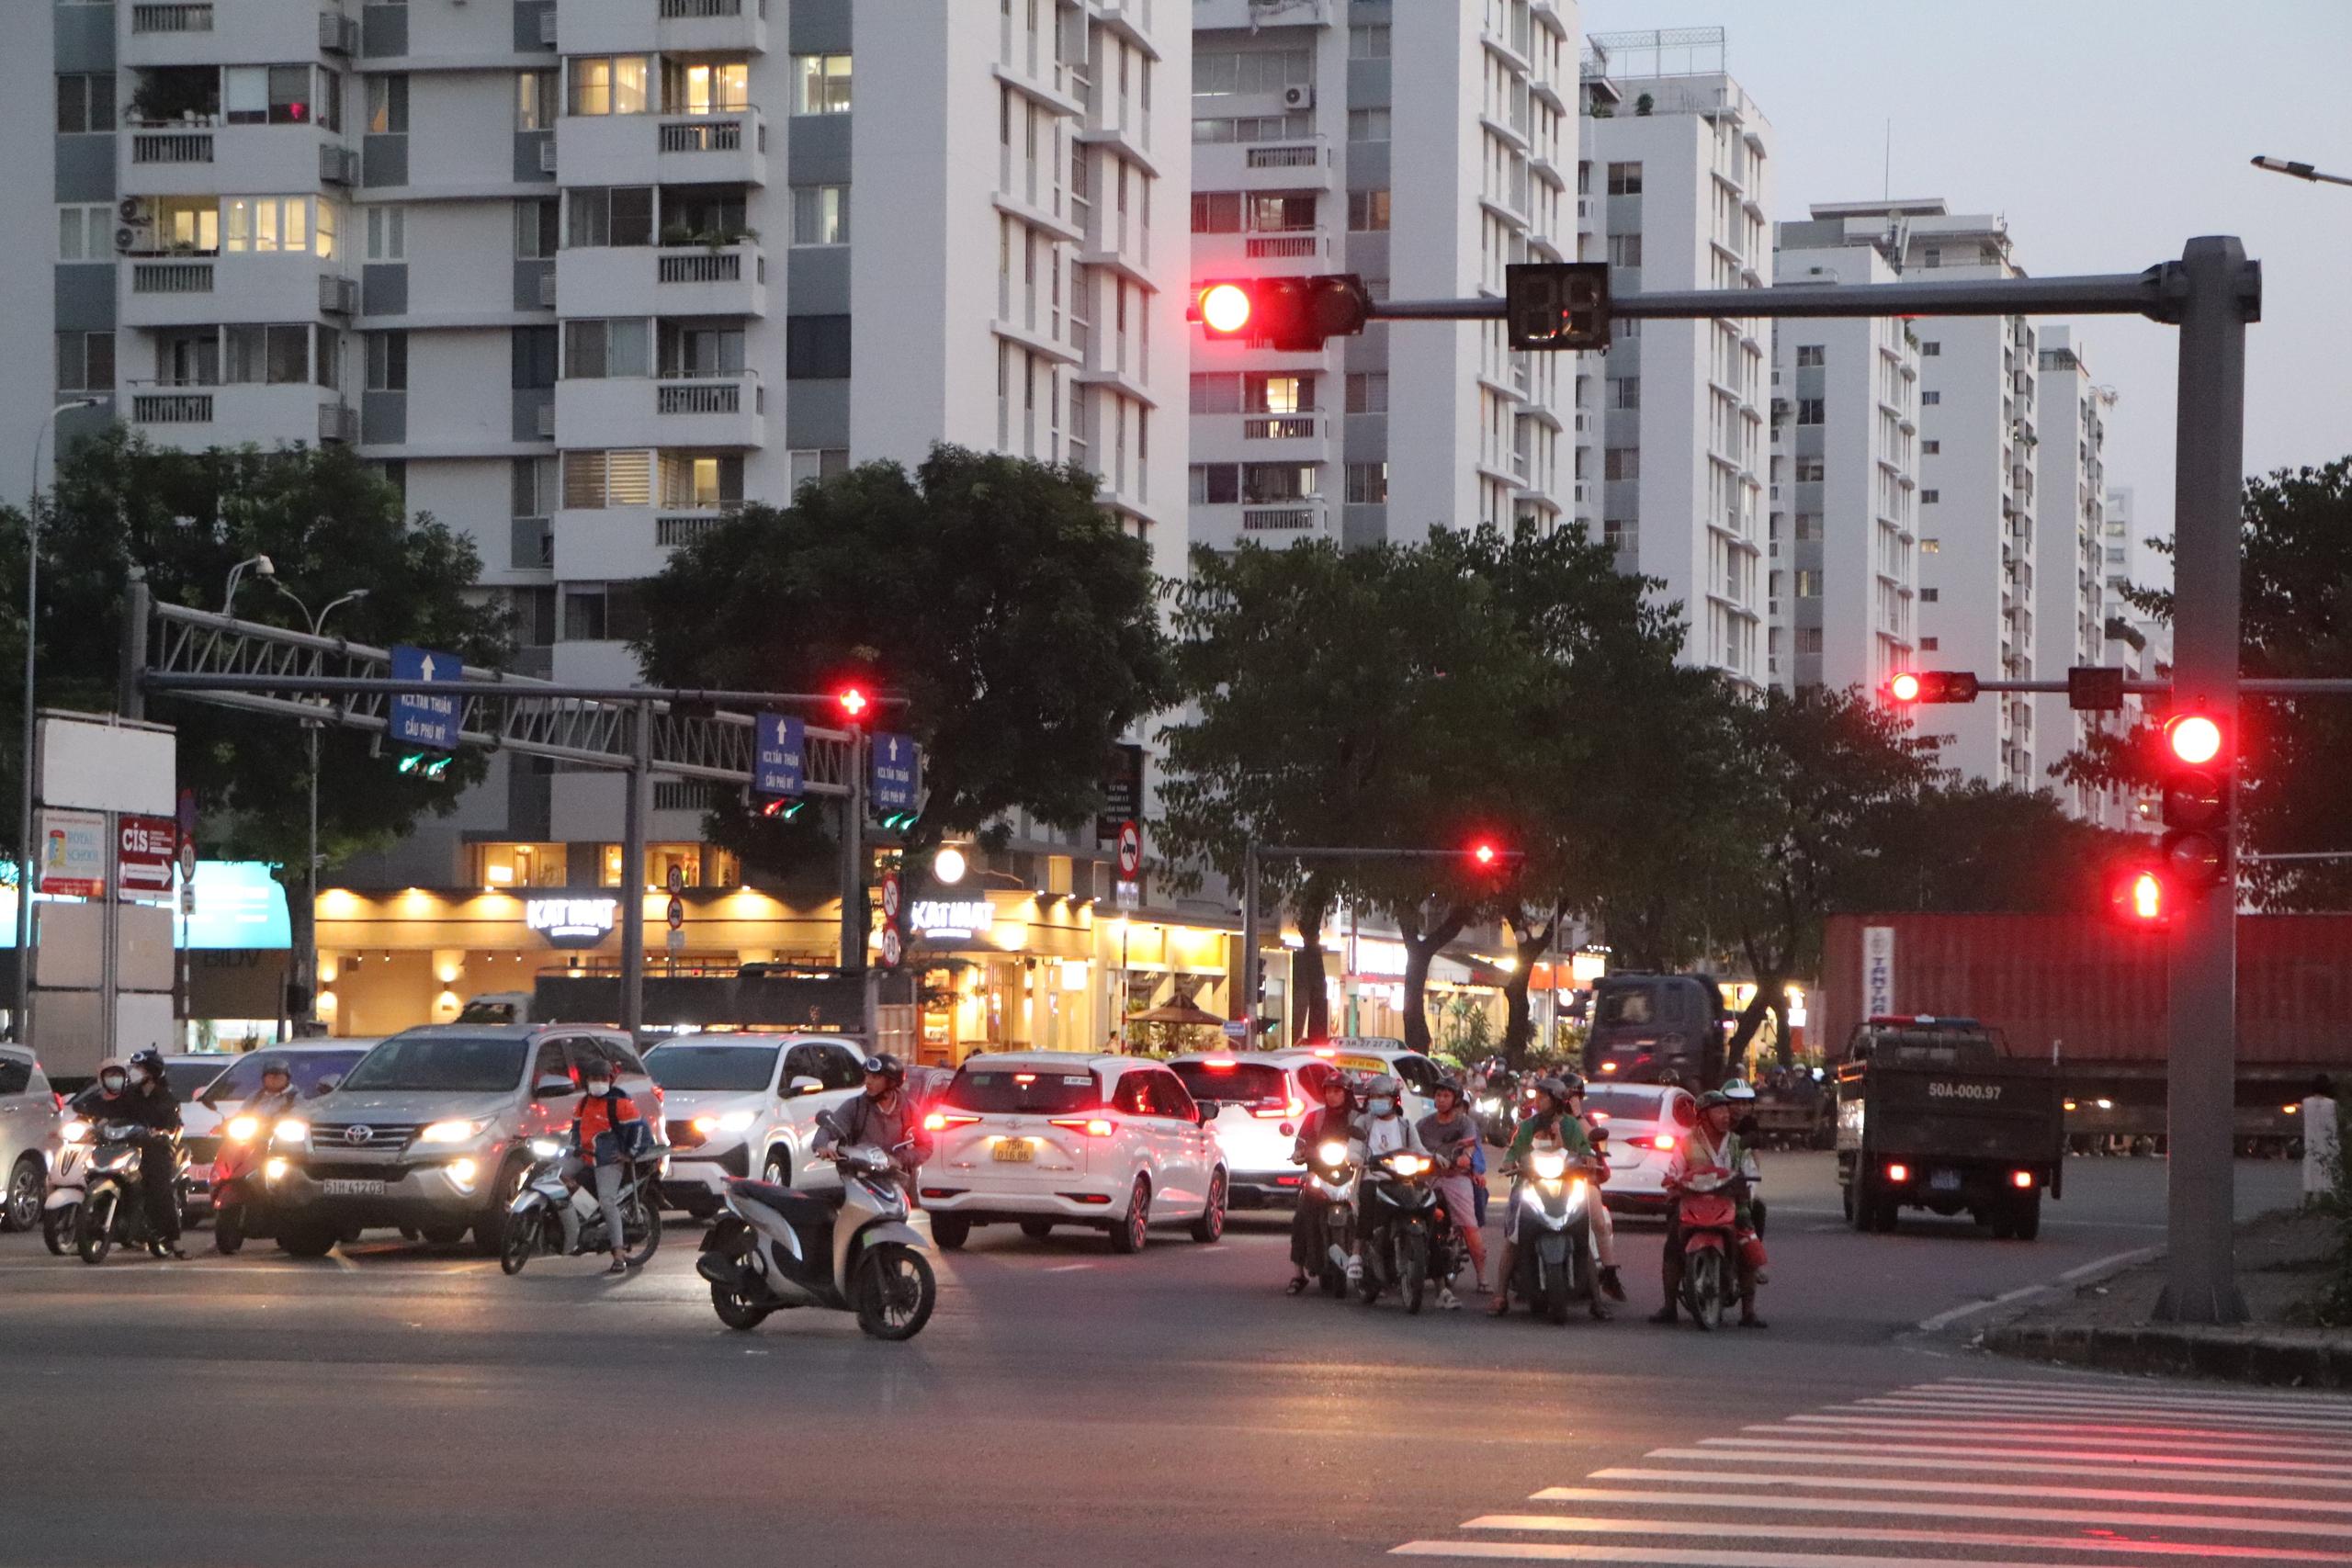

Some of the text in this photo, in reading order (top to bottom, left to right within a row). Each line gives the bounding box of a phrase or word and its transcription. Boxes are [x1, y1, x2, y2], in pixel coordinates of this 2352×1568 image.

[420, 721, 435, 739] PHÚ
[67, 830, 95, 845] ROYAL
[66, 850, 99, 863] SCHOOL
[1928, 1083, 2002, 1100] 50A-000.97
